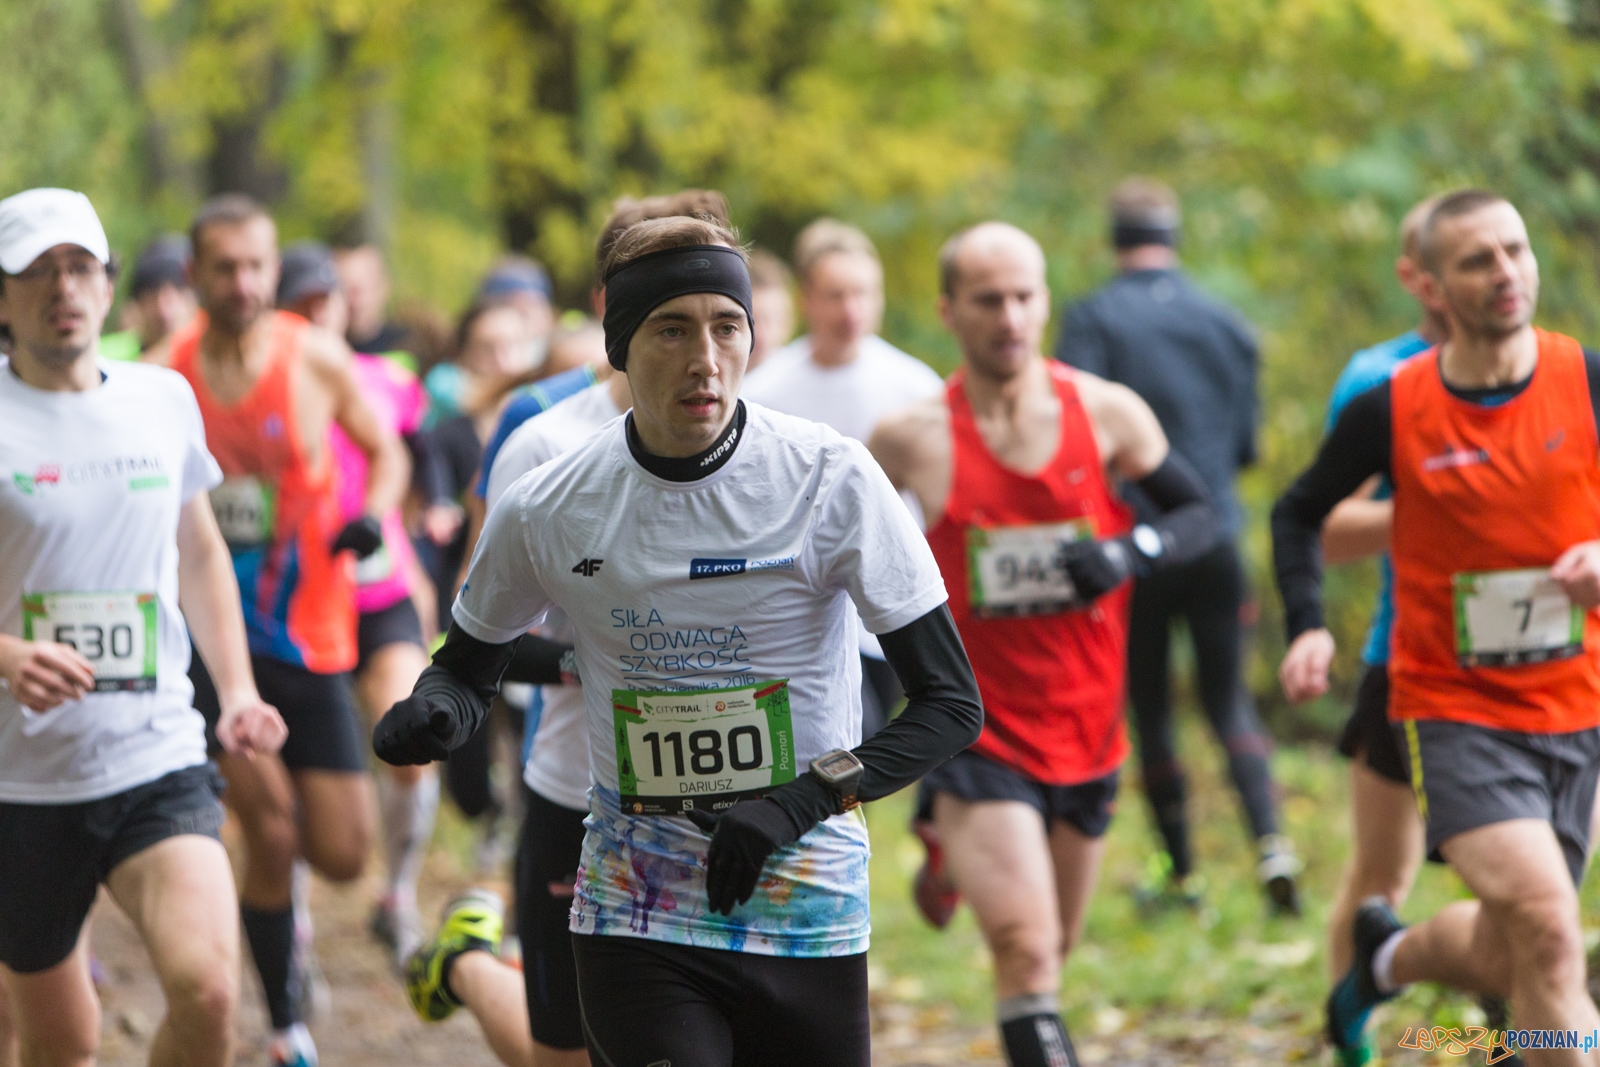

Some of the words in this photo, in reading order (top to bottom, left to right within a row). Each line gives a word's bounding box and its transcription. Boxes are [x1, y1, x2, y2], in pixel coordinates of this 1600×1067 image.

[571, 558, 604, 577] 4F
[714, 564, 742, 573] PKO
[611, 608, 665, 628] SIŁA
[1512, 599, 1534, 635] 7
[630, 625, 748, 652] ODWAGA
[619, 643, 751, 673] SZYBKOŚĆ
[723, 674, 756, 688] 2016
[643, 724, 763, 777] 1180
[776, 730, 790, 770] Poznań
[679, 779, 733, 794] DARIUSZ
